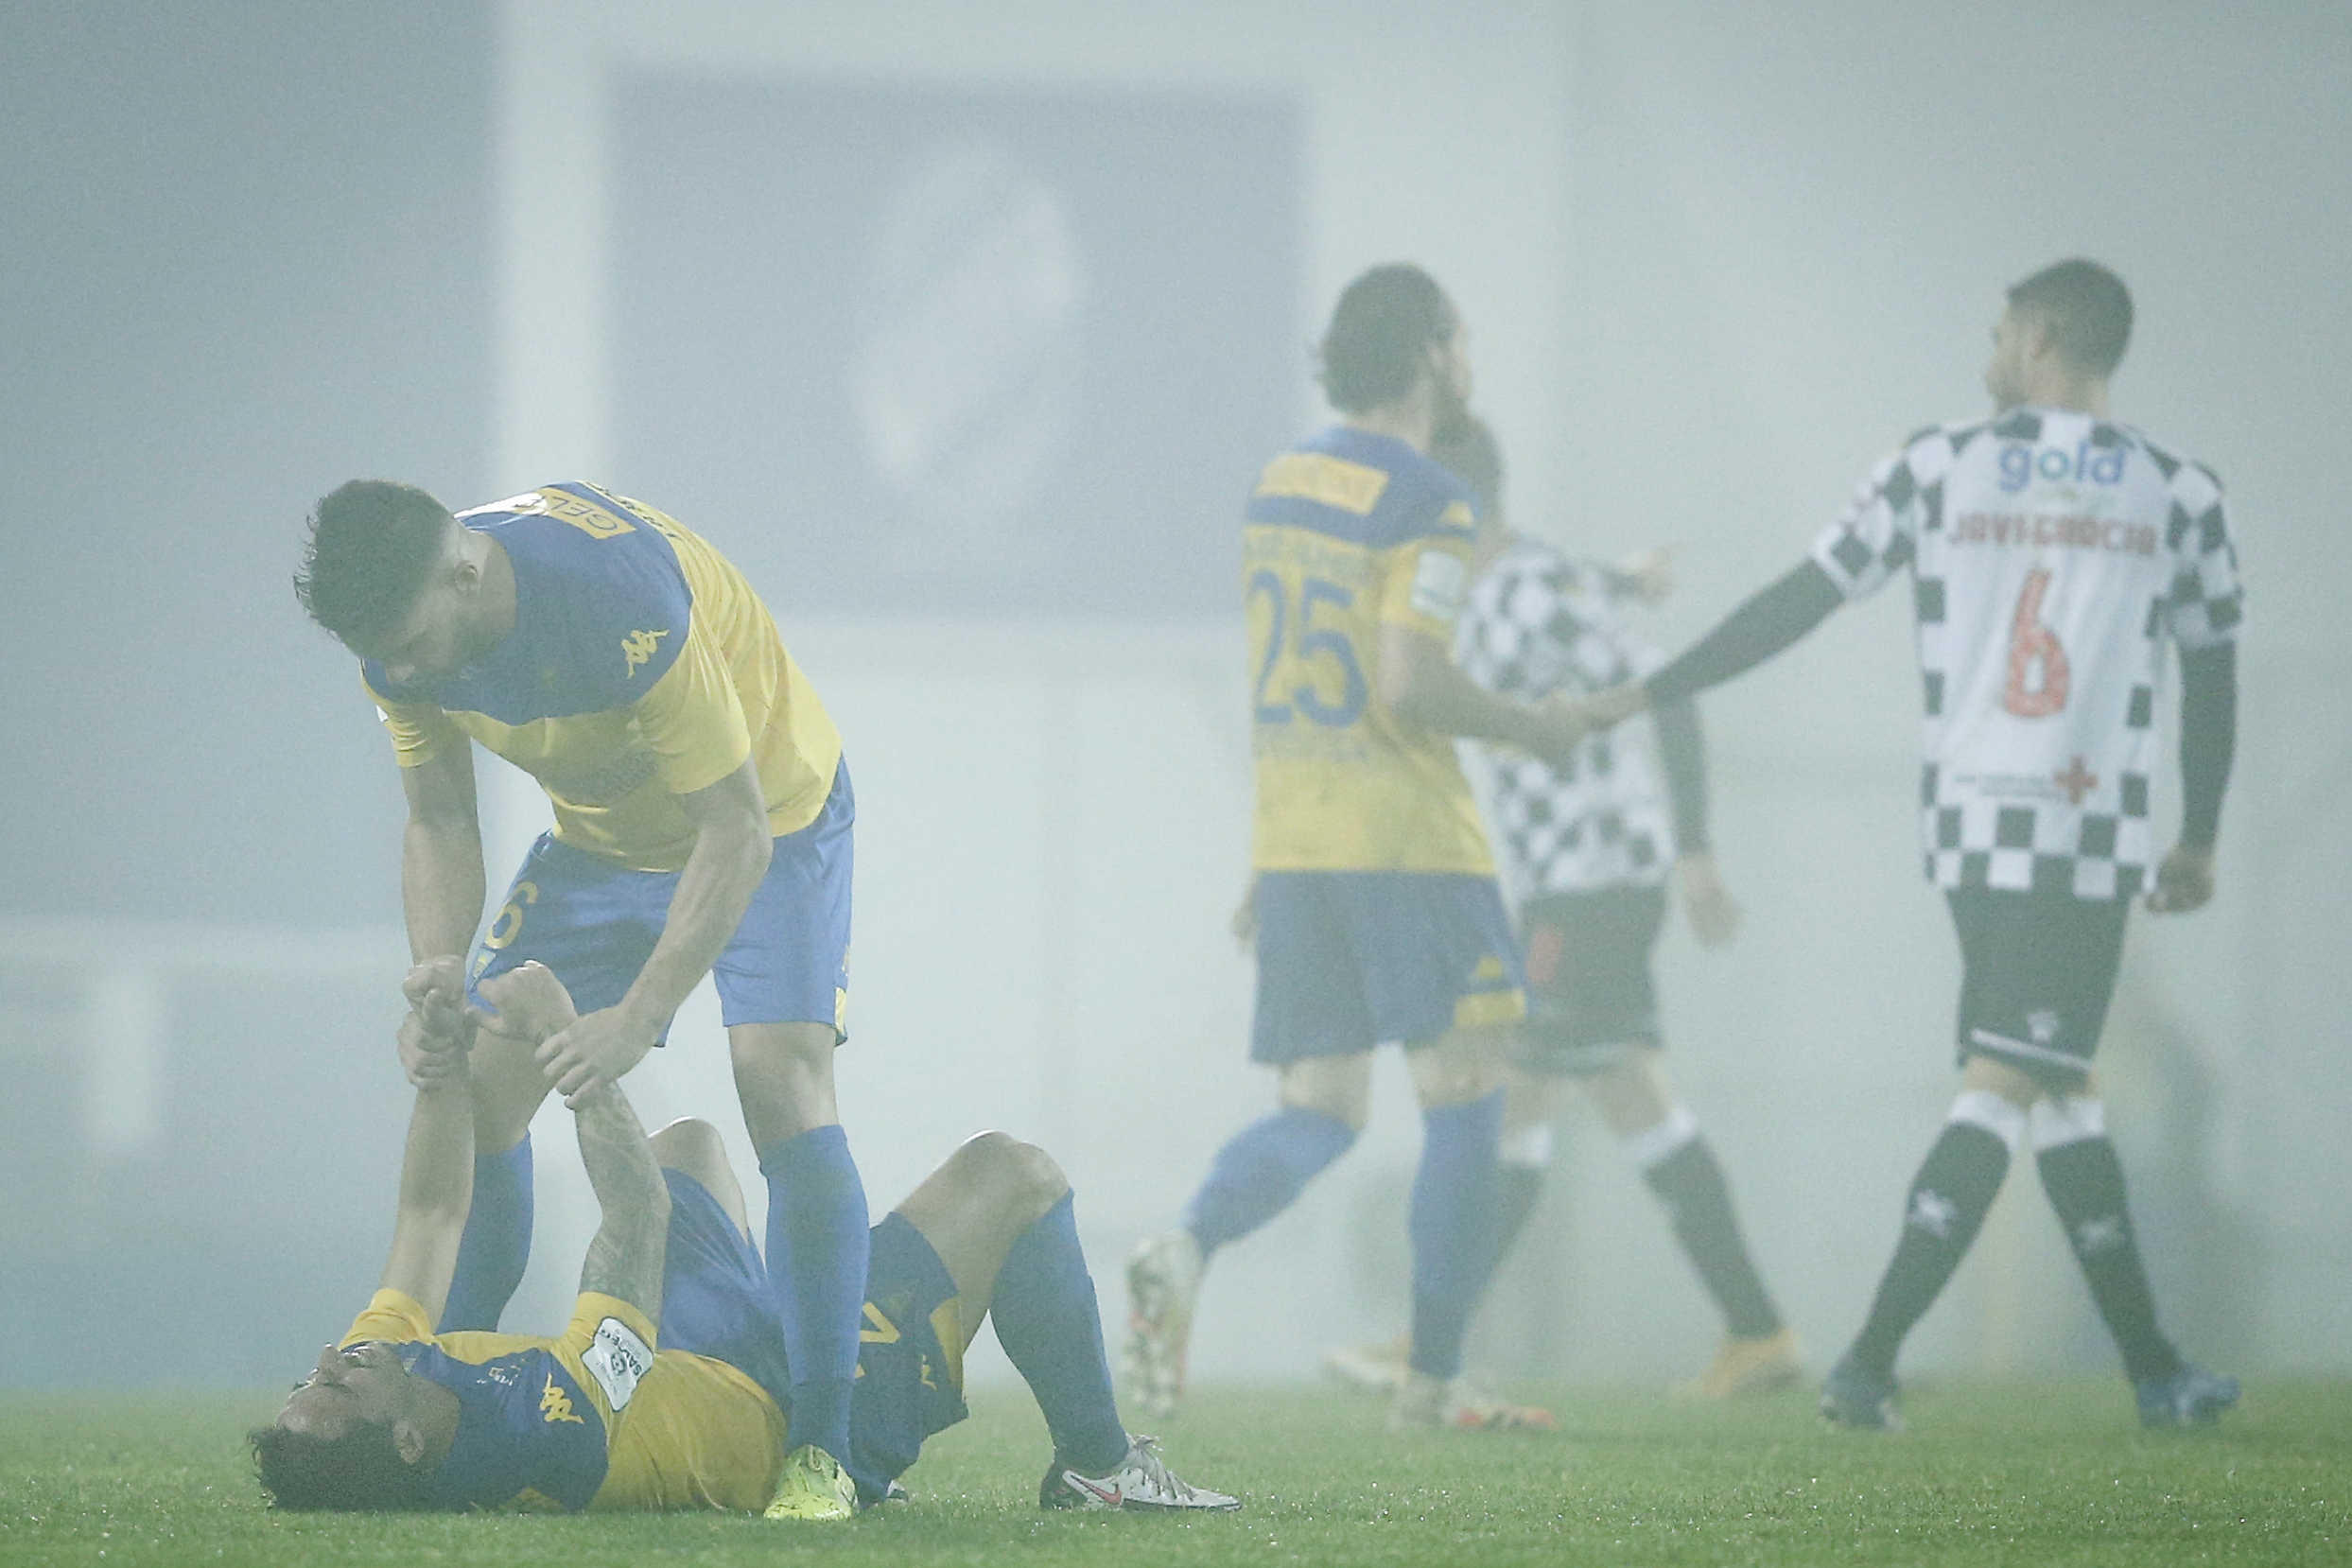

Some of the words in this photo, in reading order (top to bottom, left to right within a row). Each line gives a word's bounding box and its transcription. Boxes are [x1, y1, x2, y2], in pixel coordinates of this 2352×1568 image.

[1998, 441, 2126, 493] gold
[1250, 569, 1368, 728] 25
[2004, 566, 2070, 719] 6
[485, 880, 539, 950] 6
